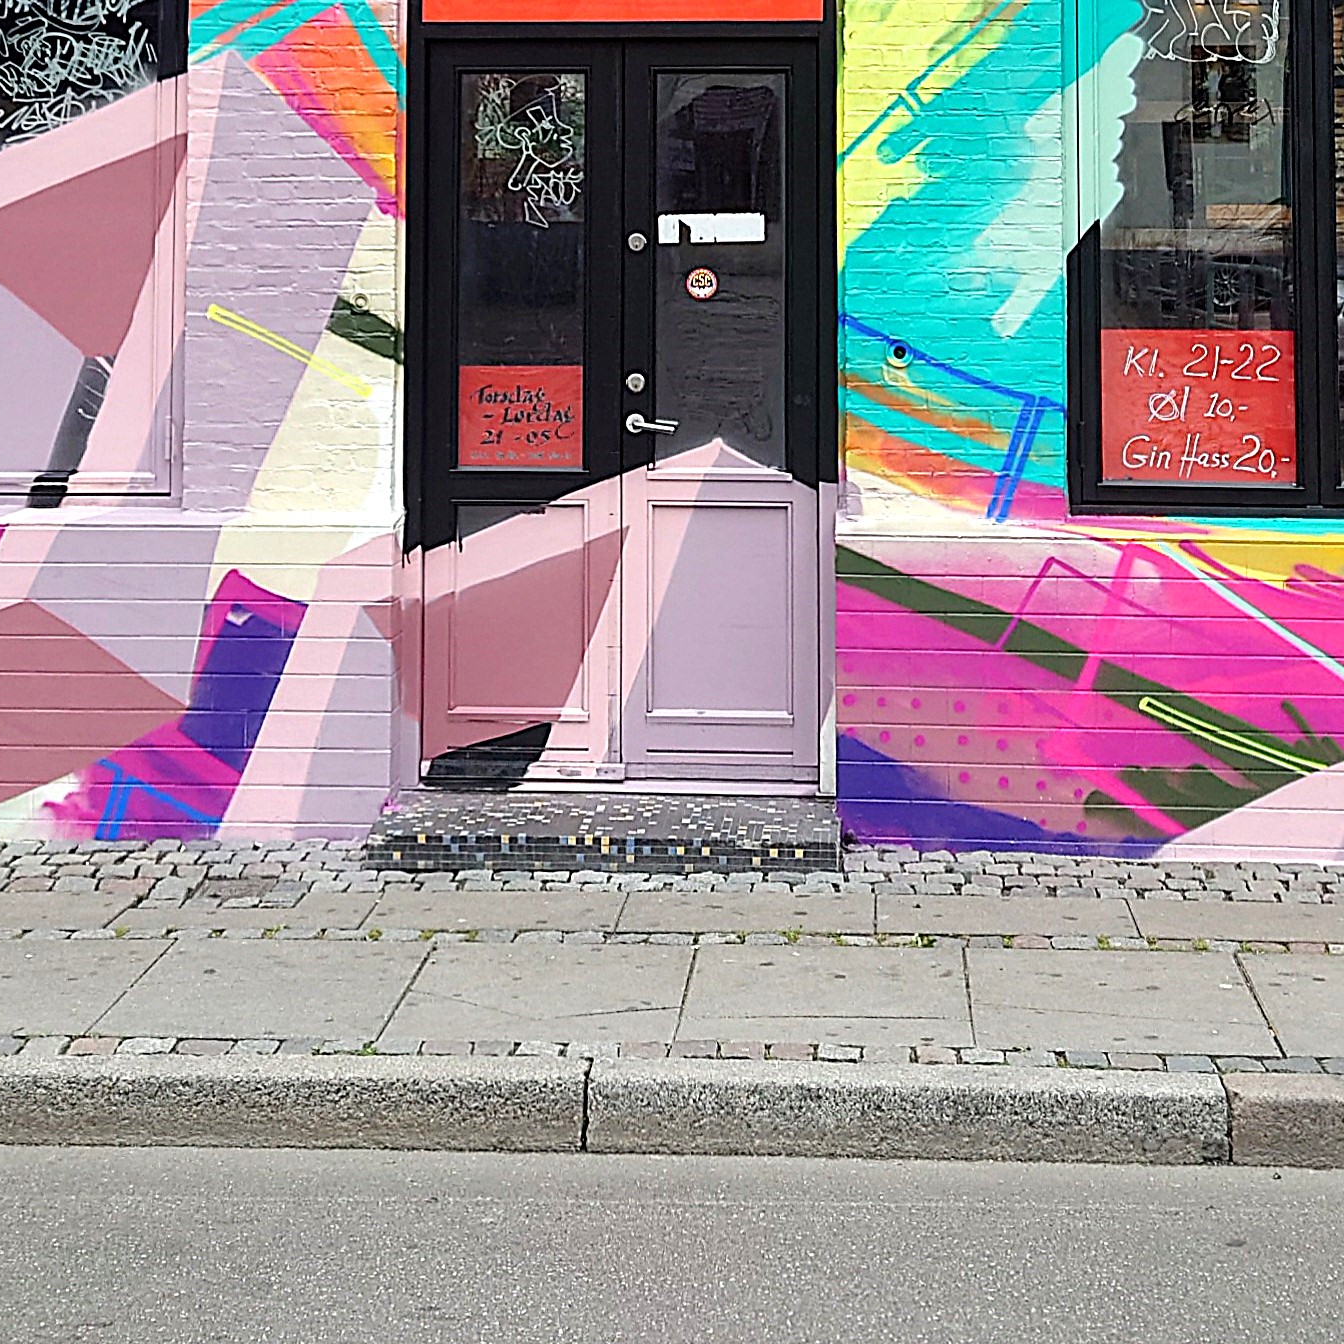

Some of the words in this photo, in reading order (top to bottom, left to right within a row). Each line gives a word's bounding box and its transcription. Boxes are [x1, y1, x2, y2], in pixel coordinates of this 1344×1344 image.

[692, 273, 712, 286] CSC
[1182, 343, 1281, 382] 21-22
[1148, 385, 1191, 423] Øl
[1122, 434, 1171, 470] Gin
[1178, 432, 1230, 479] Hass
